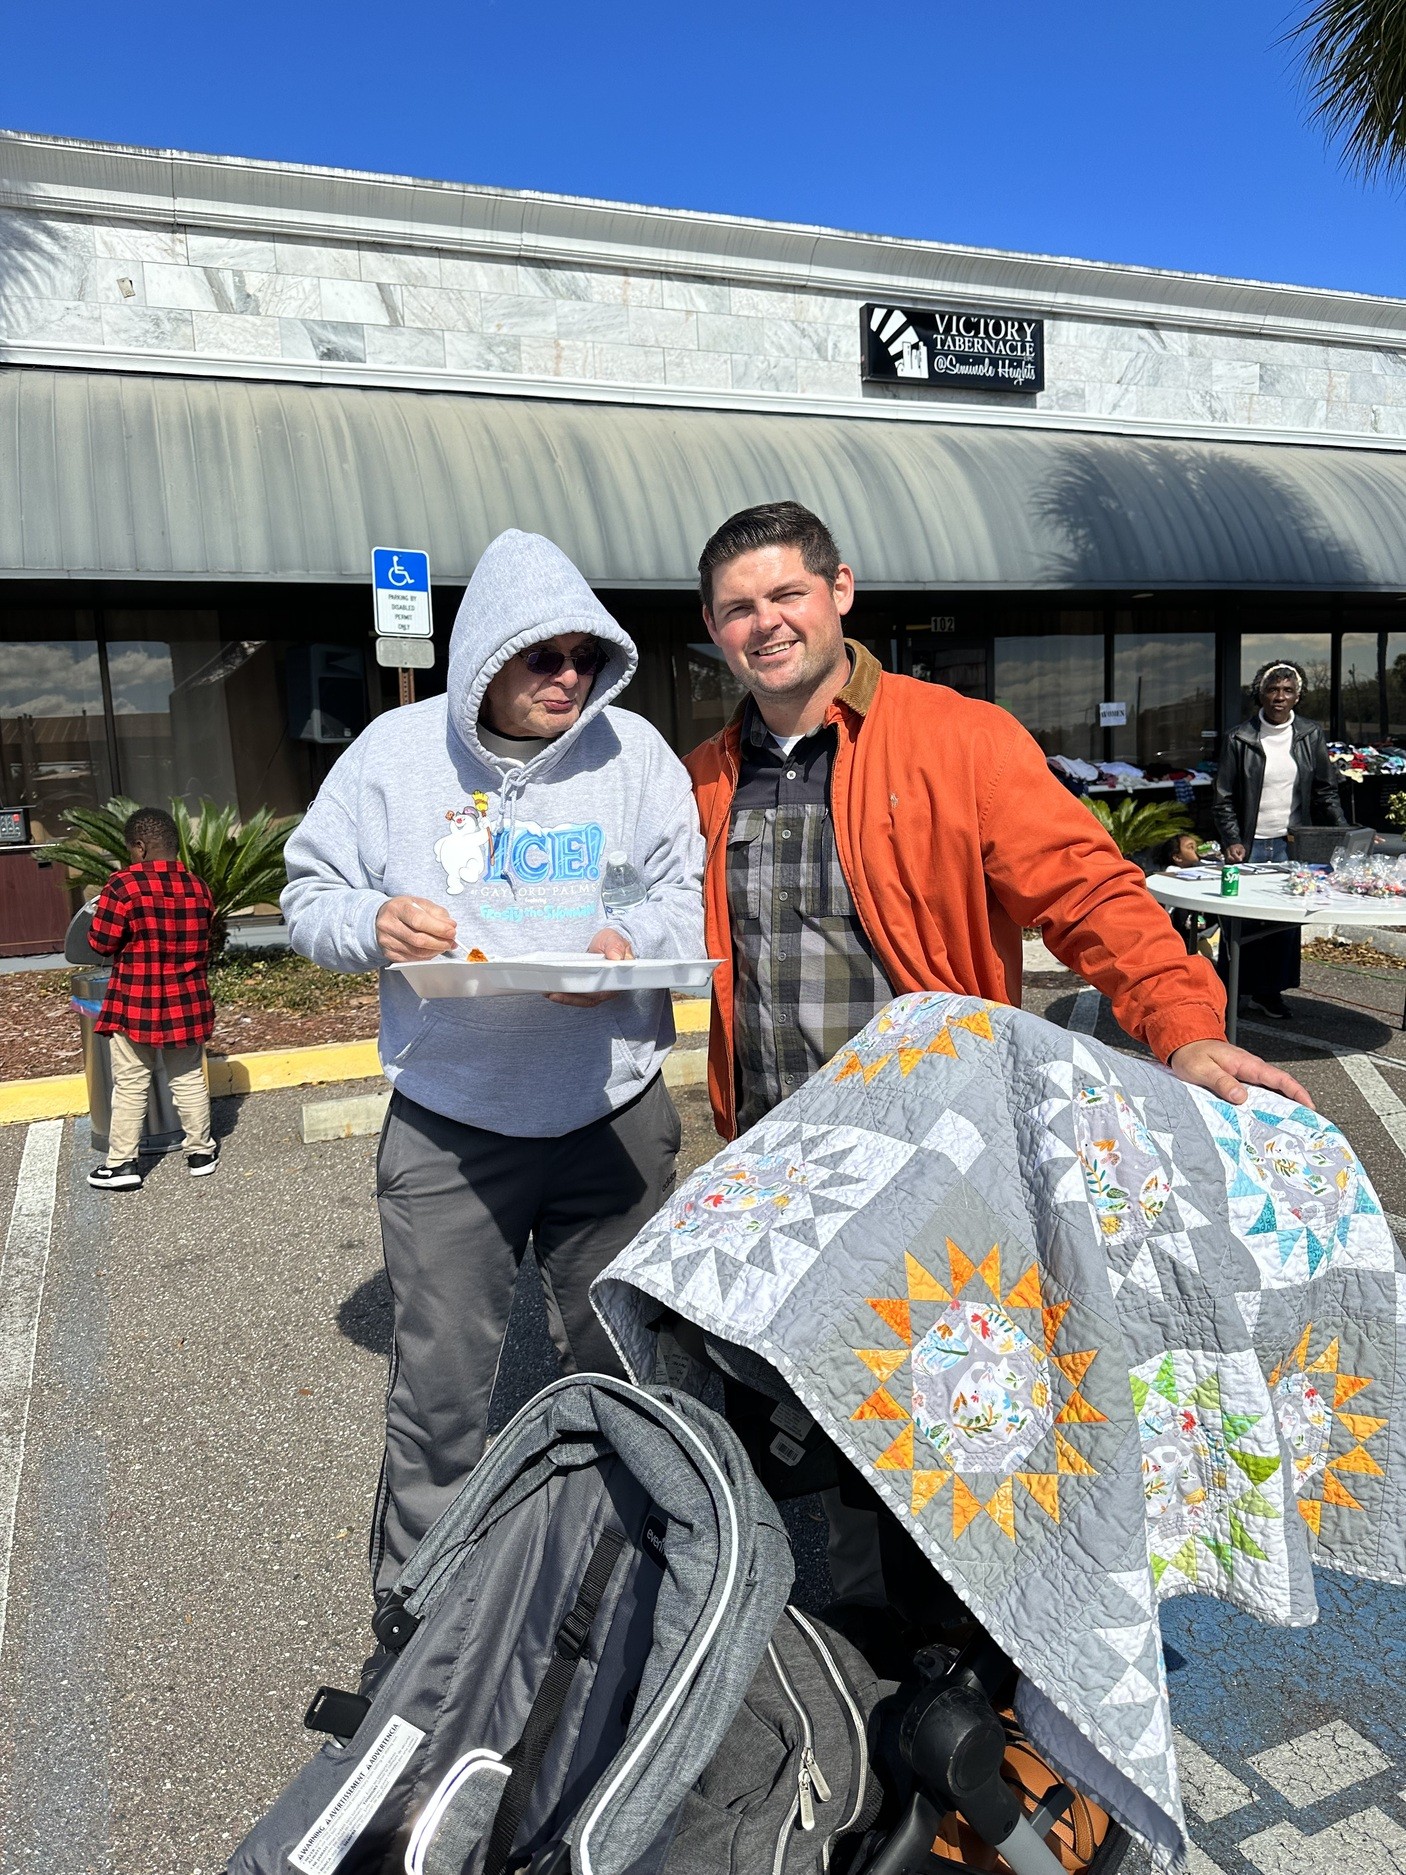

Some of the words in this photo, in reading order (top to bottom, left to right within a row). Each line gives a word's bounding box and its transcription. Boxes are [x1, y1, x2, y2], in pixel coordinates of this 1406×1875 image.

[934, 314, 1036, 342] VICTORY
[933, 334, 1036, 357] TABERNACLE
[934, 355, 995, 377] @Seminole
[997, 359, 1036, 386] Heights
[932, 617, 955, 631] 102
[1101, 710, 1125, 718] WOMEN
[483, 824, 604, 882] ICE!
[480, 886, 546, 897] GAYORD
[300, 1825, 326, 1855] WARNING
[328, 1771, 366, 1820] AVERTISSEMENT
[369, 1723, 399, 1765] ADVERTENCIA
